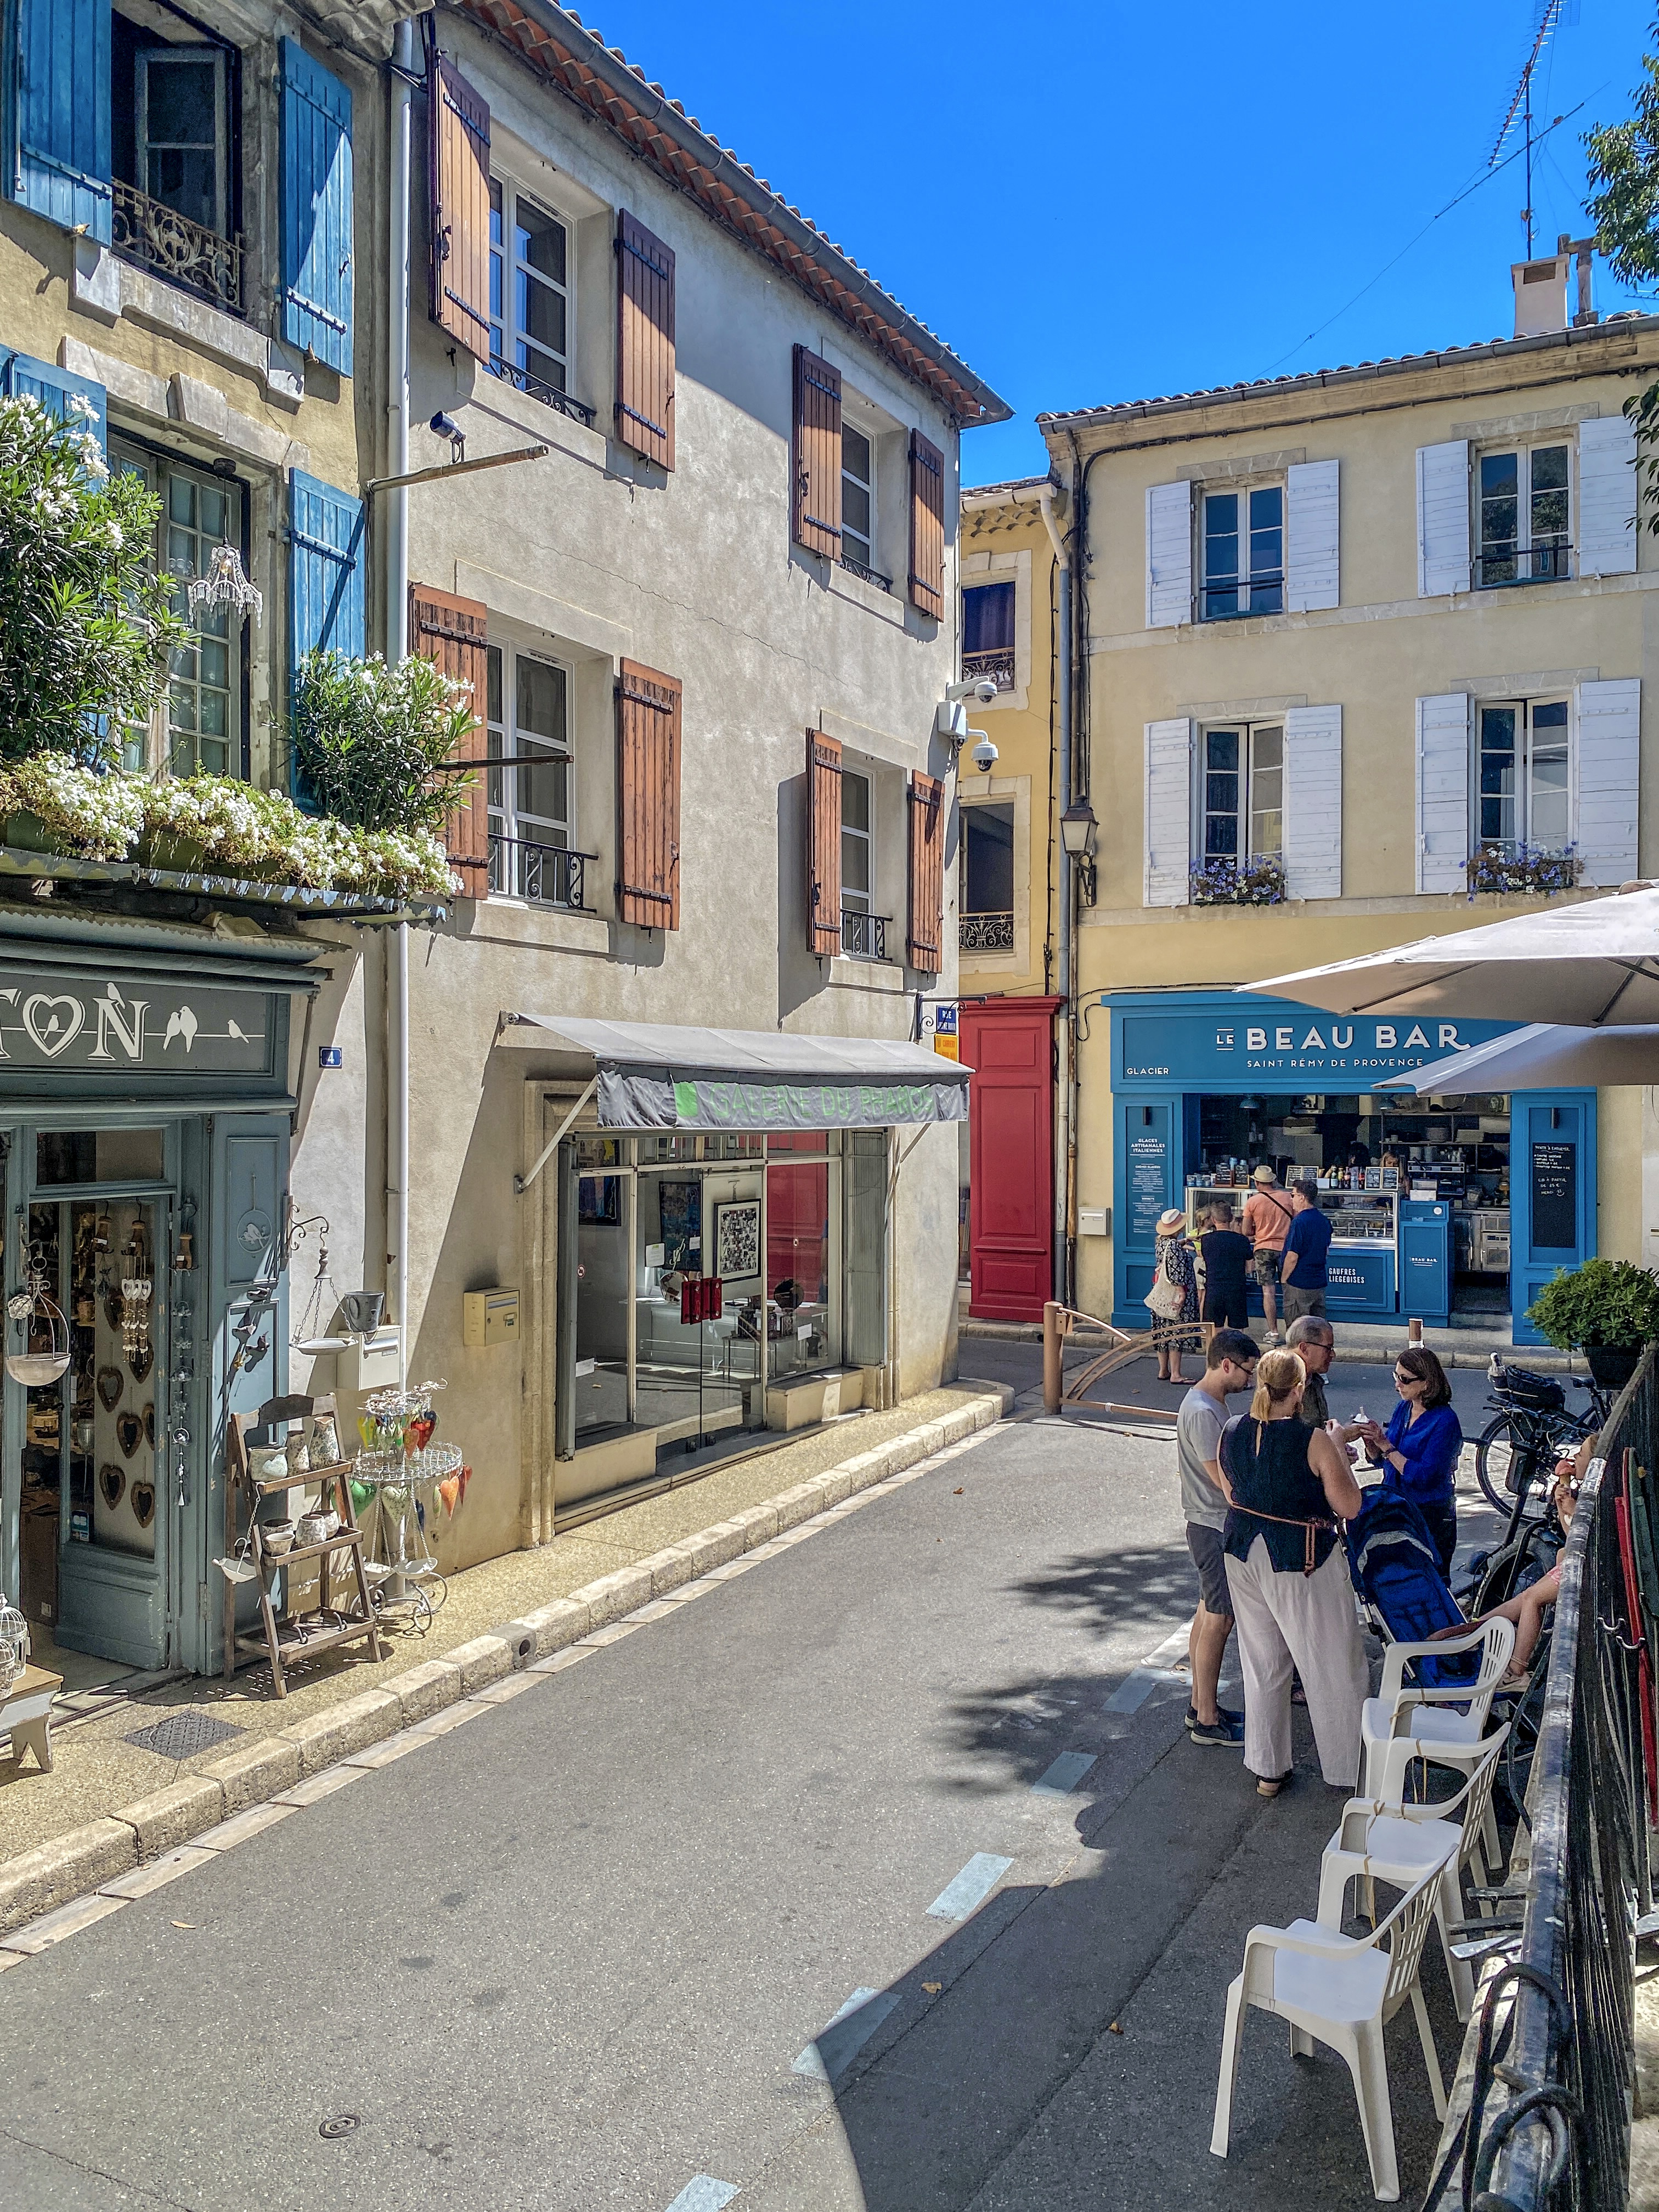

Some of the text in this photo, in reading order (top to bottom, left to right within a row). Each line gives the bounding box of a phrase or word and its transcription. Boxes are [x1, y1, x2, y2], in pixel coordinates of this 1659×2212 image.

[941, 1010, 952, 1019] RUE
[1216, 1023, 1471, 1051] LE BEAU BAR
[328, 1051, 335, 1064] 4
[1247, 1058, 1424, 1068] SAINT RÉMY DE PROVENCE
[1126, 1067, 1170, 1075] GLACIER
[710, 1082, 933, 1118] GALERIE DU PHAROS
[1329, 1276, 1364, 1284] LIEGEOISES
